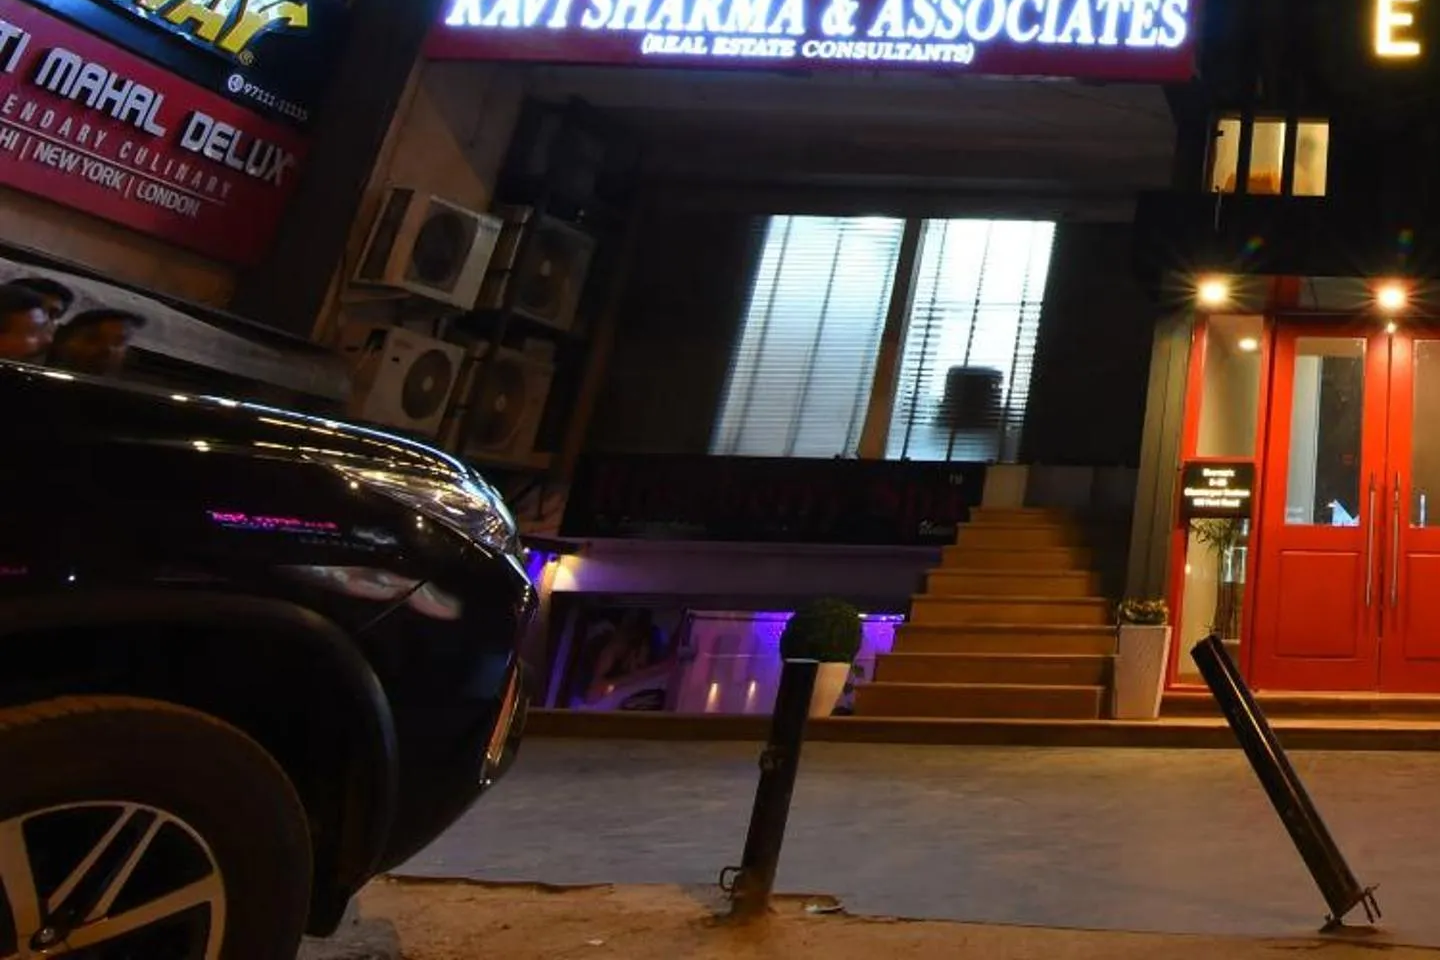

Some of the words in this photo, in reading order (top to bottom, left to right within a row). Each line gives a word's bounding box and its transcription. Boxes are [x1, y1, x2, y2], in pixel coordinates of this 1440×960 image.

[641, 33, 707, 56] (REAL
[710, 36, 796, 58] ESTATE
[801, 40, 975, 66] CONSULTANTS)
[35, 47, 167, 138] MAHAL
